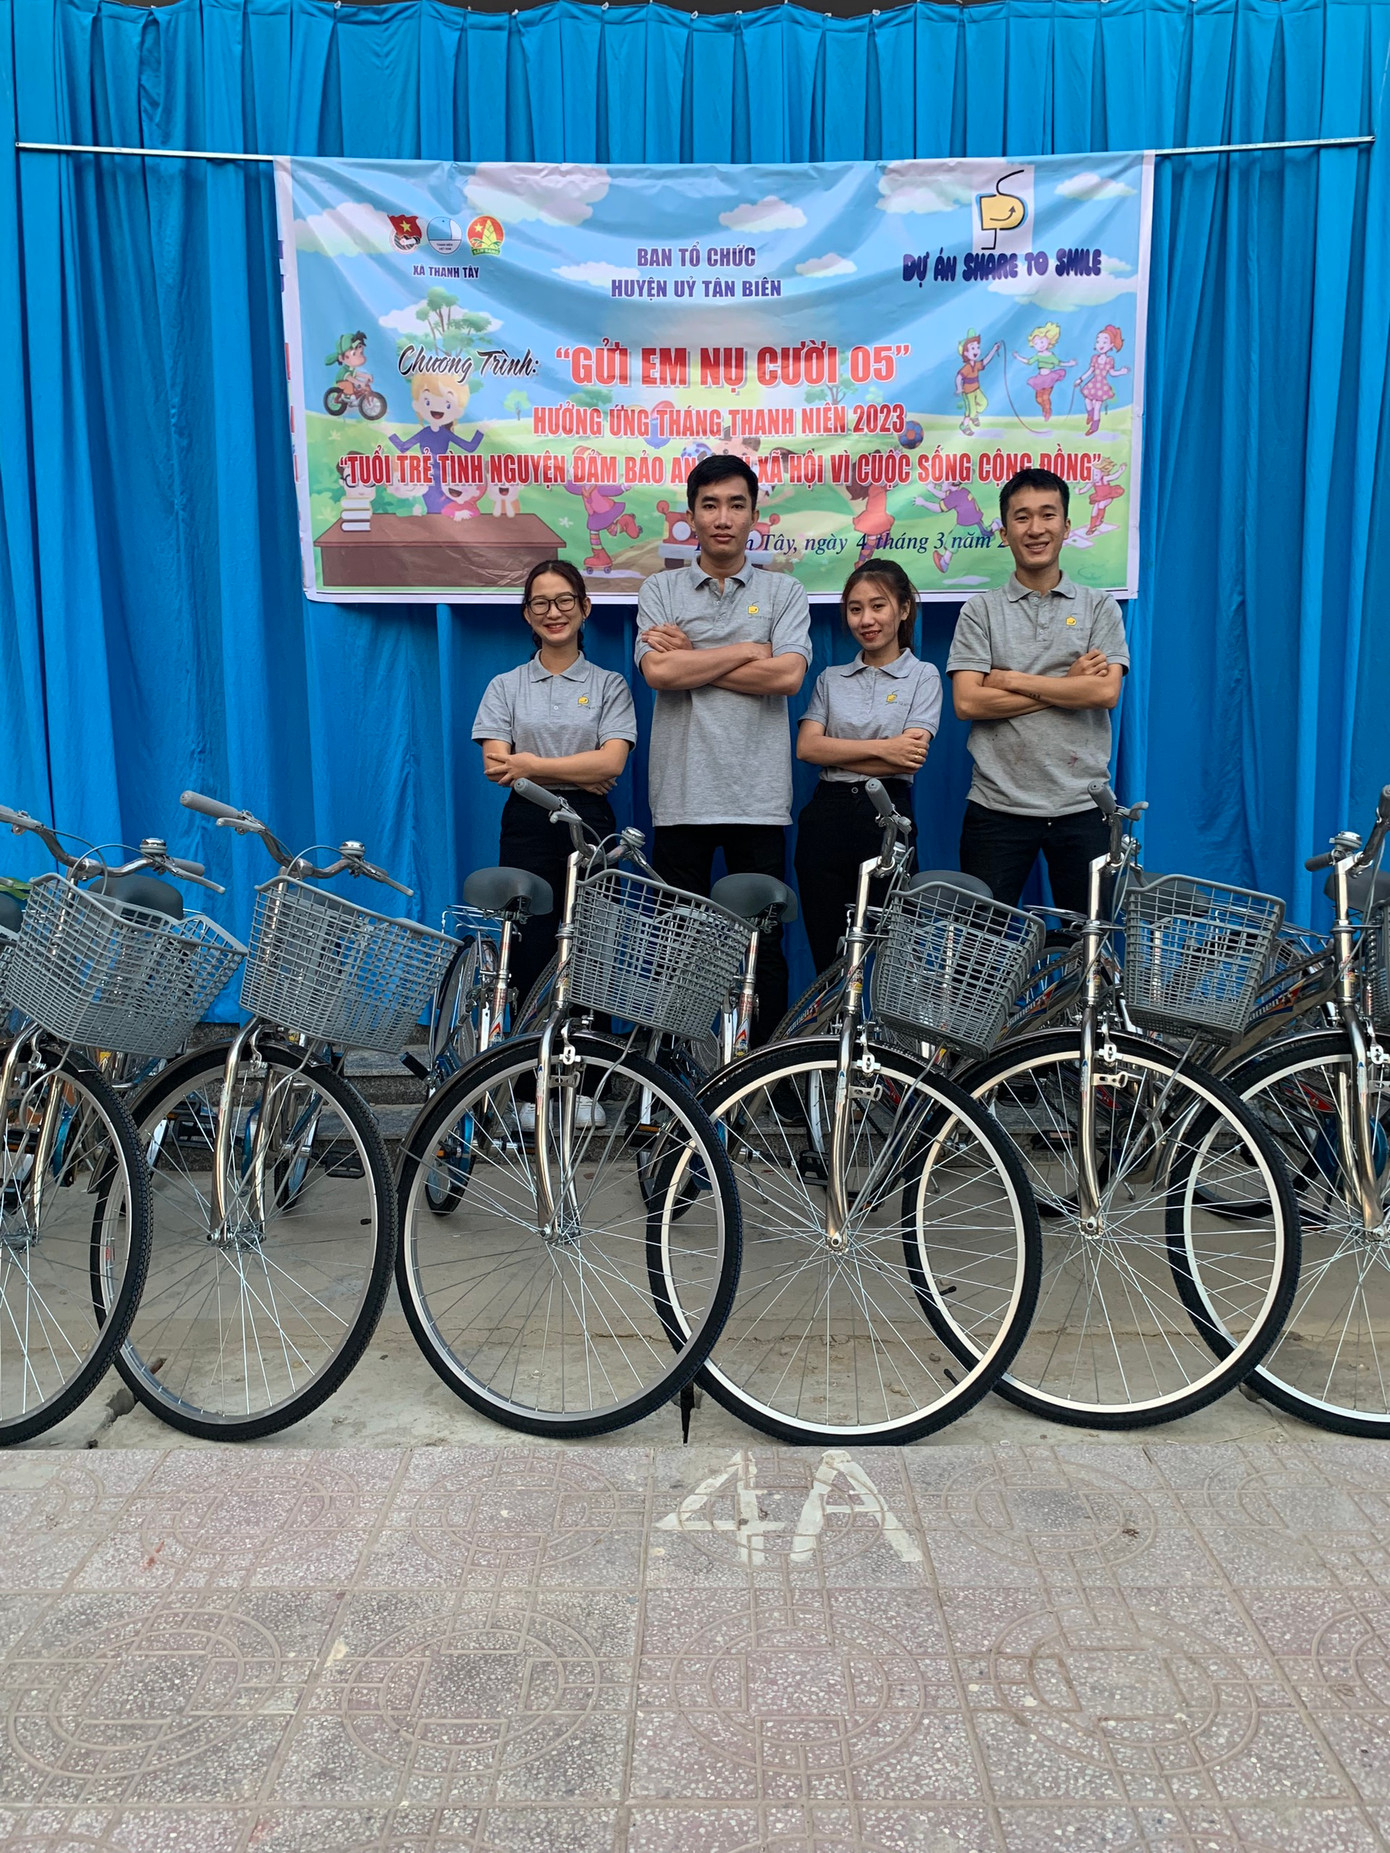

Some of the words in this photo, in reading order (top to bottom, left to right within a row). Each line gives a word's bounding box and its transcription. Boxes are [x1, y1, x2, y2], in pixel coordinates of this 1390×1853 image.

[462, 265, 480, 278] TÂY
[637, 248, 672, 267] BAN
[678, 241, 700, 267] TỔ
[707, 244, 756, 267] CHỨC
[902, 251, 930, 288] DỰ
[933, 247, 957, 282] ÁN
[962, 252, 1019, 282] SHARE
[1024, 251, 1049, 276] TO
[1055, 248, 1102, 277] SMILE
[611, 277, 667, 301] HUYỆN
[674, 275, 696, 297] UỶ
[702, 277, 735, 297] TÂN
[742, 276, 781, 297] BIÊN
[398, 344, 473, 384] Chương
[476, 348, 539, 377] Trình:
[555, 337, 629, 386] “GỬI
[641, 347, 688, 386] EM
[700, 347, 744, 393] NỤ
[756, 339, 838, 386] CƯỜI
[849, 344, 910, 383] 05”
[533, 401, 602, 436] HƯỞNG
[609, 404, 650, 437] ỨNG
[657, 405, 722, 437] THÁNG
[729, 408, 794, 436] THANH
[801, 402, 846, 434] NIÊN
[853, 403, 905, 434] 2023
[340, 445, 391, 484] “TUỔI
[397, 447, 433, 484] TRẺ
[438, 450, 484, 484] TÌNH
[490, 450, 566, 489] NGUYỆN
[573, 449, 619, 484] ĐẢM
[624, 450, 664, 484] BẢO
[757, 451, 783, 484] XÃ
[788, 450, 824, 489] HỘI
[830, 450, 850, 484] VÌ
[857, 449, 911, 489] CUỘC
[917, 444, 972, 483] SỐNG
[762, 533, 798, 556] Tây,
[804, 533, 848, 556] ngày
[856, 533, 867, 550] 4
[875, 532, 929, 554] tháng
[934, 531, 945, 550] 3
[951, 532, 991, 549] năm
[652, 1449, 923, 1566] 4A
